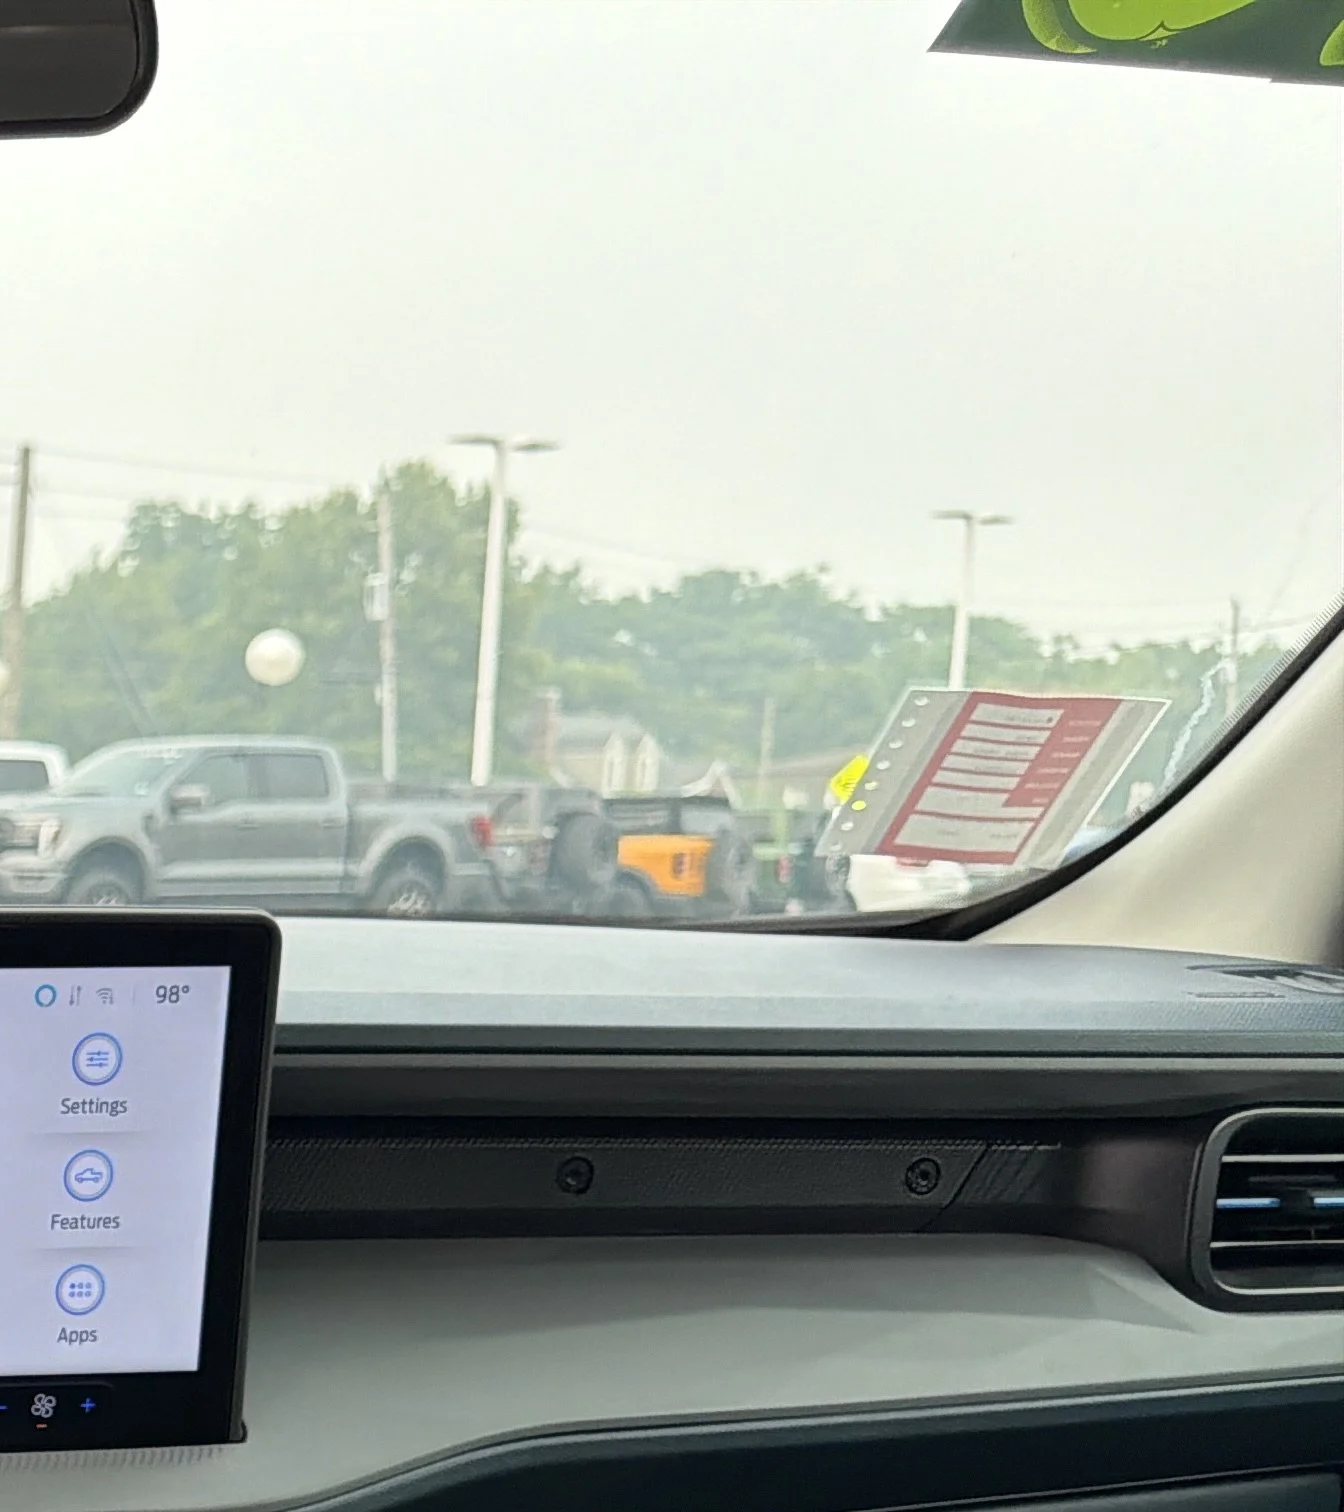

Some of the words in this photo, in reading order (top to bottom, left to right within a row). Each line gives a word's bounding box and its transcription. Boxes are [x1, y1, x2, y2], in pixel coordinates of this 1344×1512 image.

[155, 985, 190, 1004] 98°
[60, 1098, 128, 1117] Settings
[50, 1213, 121, 1231] Features
[56, 1327, 98, 1346] Apps
